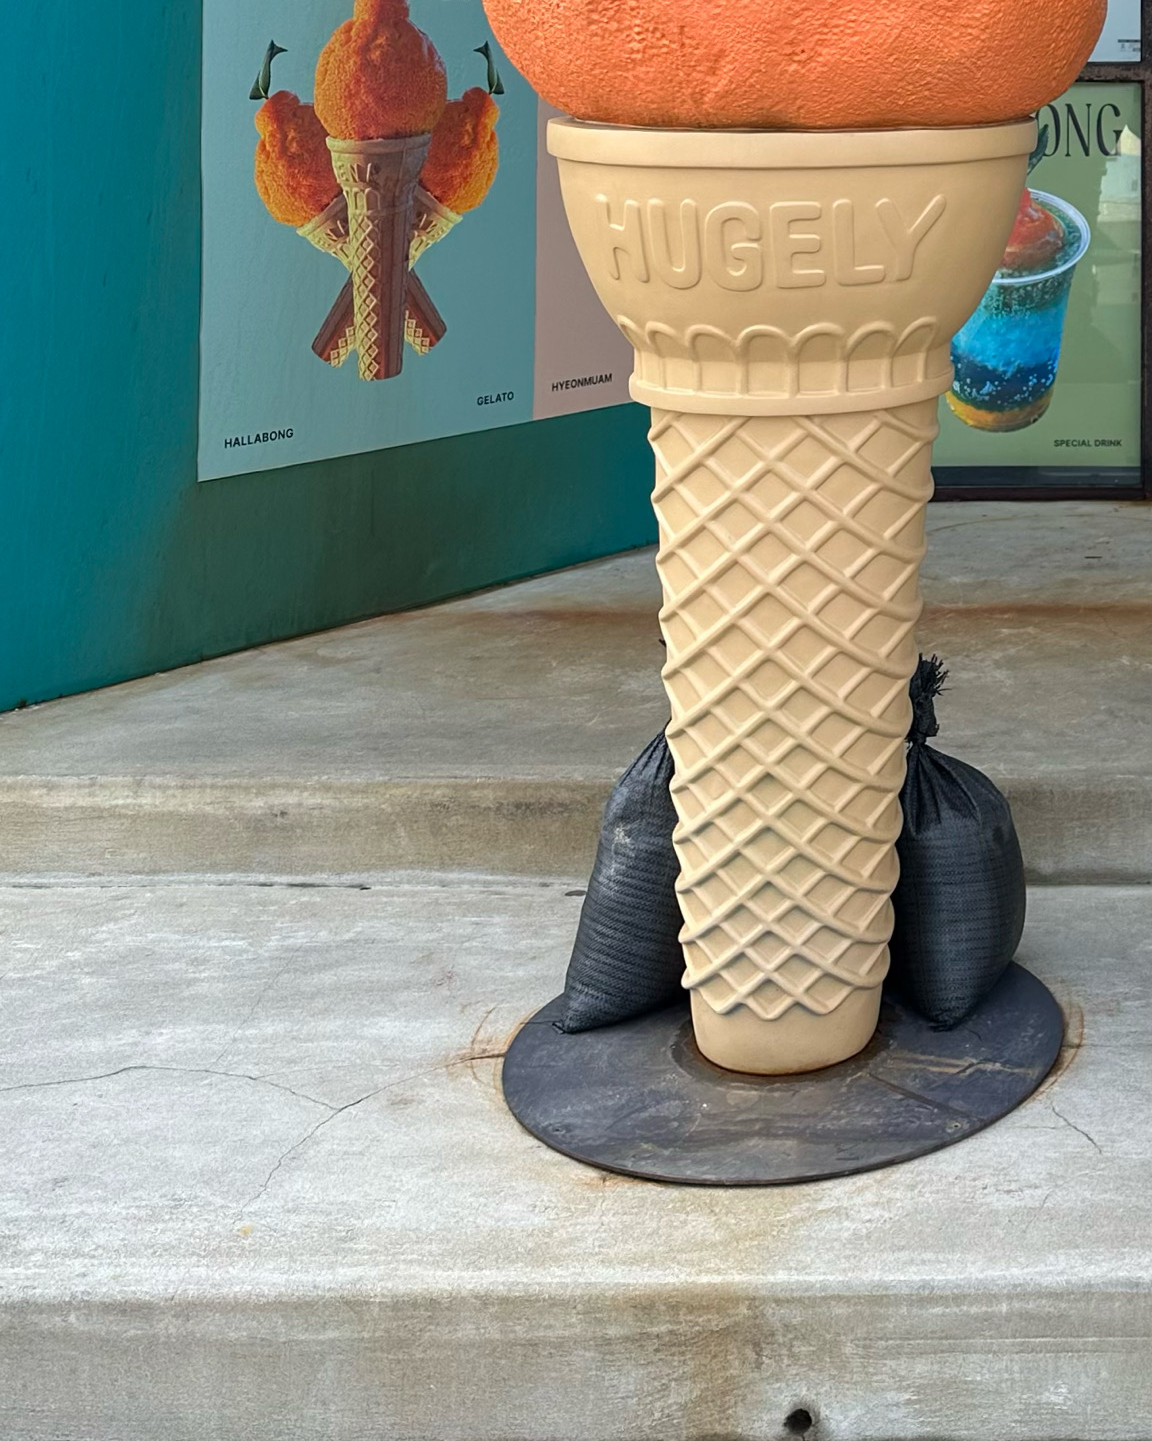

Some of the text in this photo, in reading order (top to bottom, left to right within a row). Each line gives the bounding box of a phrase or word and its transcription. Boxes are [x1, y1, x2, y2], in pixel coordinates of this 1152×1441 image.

[594, 192, 948, 292] HUGELY
[551, 372, 613, 393] HYEONMUAM
[476, 390, 515, 407] GELATO
[223, 427, 294, 449] HALLABONG
[1053, 438, 1123, 448] SPECIAL DRINK
